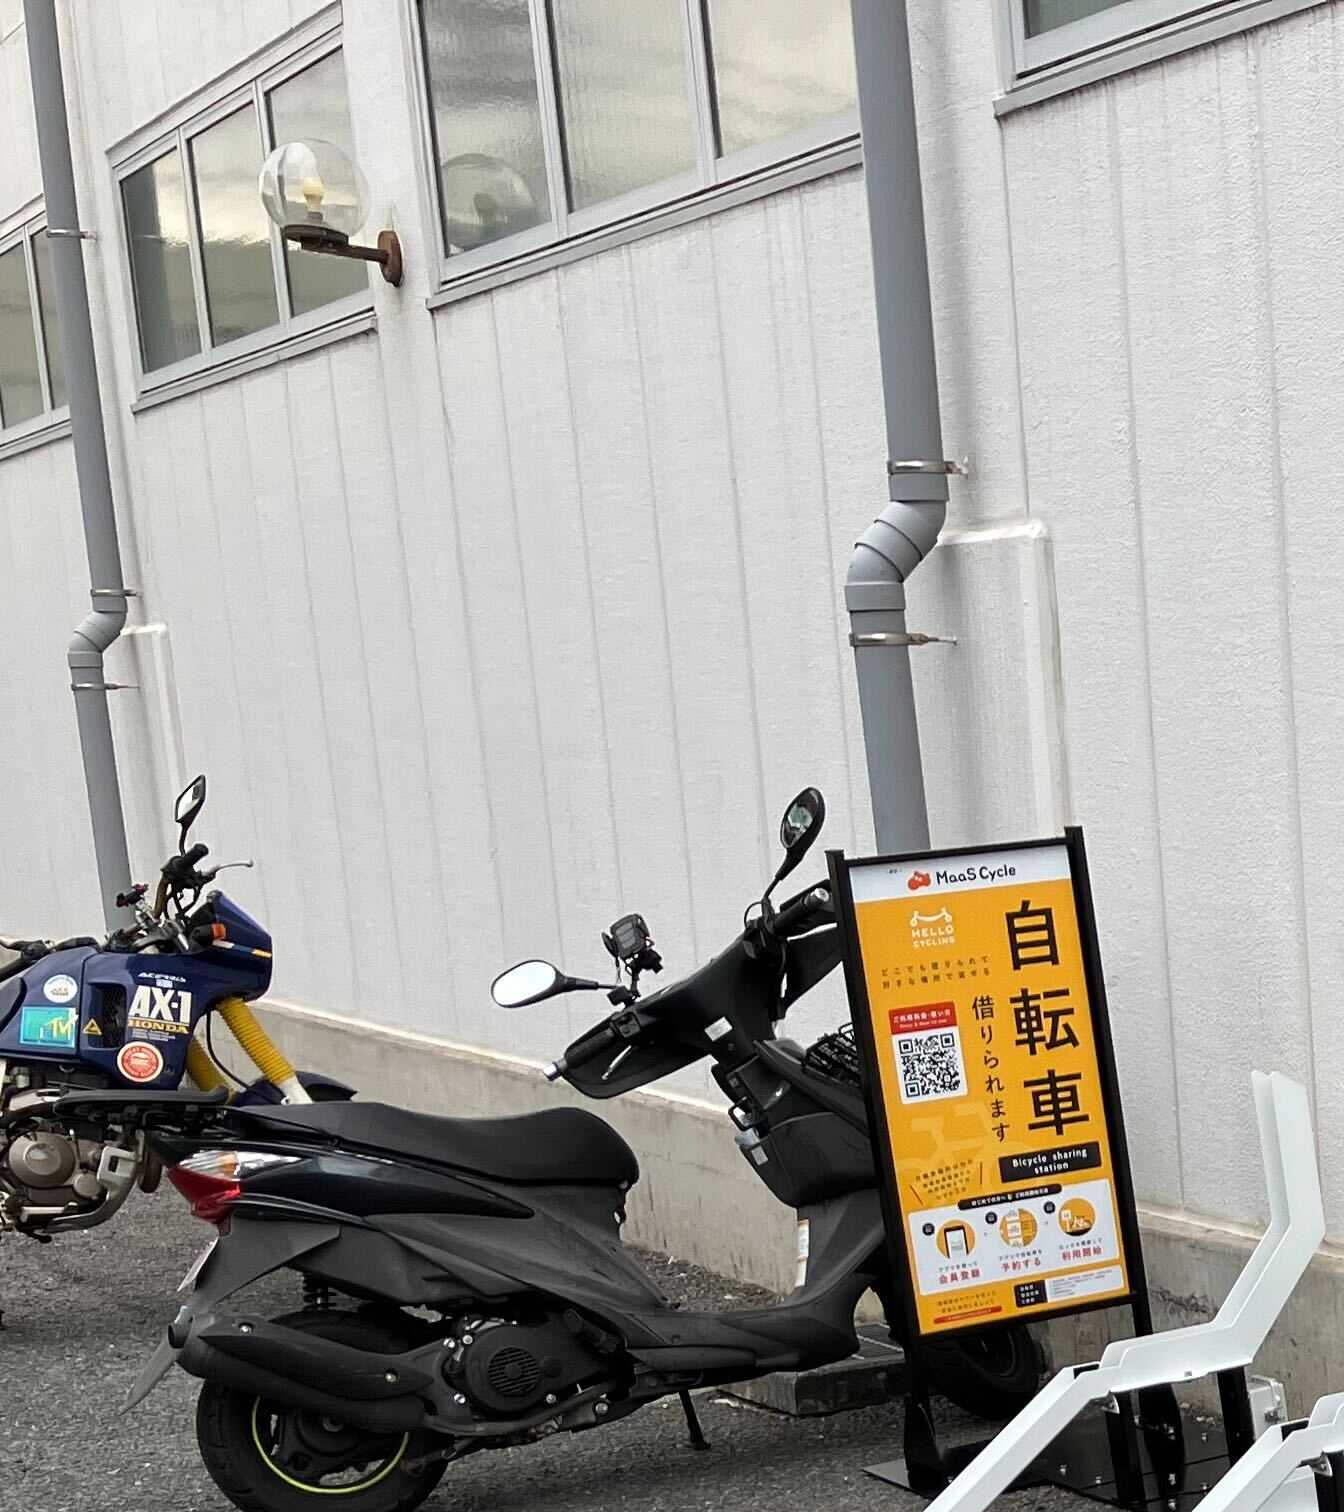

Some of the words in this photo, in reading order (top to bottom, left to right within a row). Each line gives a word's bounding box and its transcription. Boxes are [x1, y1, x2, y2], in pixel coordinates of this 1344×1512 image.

[935, 867, 977, 886] MaaS
[979, 865, 1017, 882] Cycle
[911, 925, 954, 938] HELLO
[127, 985, 192, 1024] AX-1
[127, 1018, 191, 1034] HONDA
[1005, 899, 1090, 1136] 自転車
[971, 994, 1011, 1142] 借りられます
[1012, 1154, 1047, 1168] Bicycle
[1052, 1149, 1088, 1163] sharing
[1034, 1162, 1069, 1175] station
